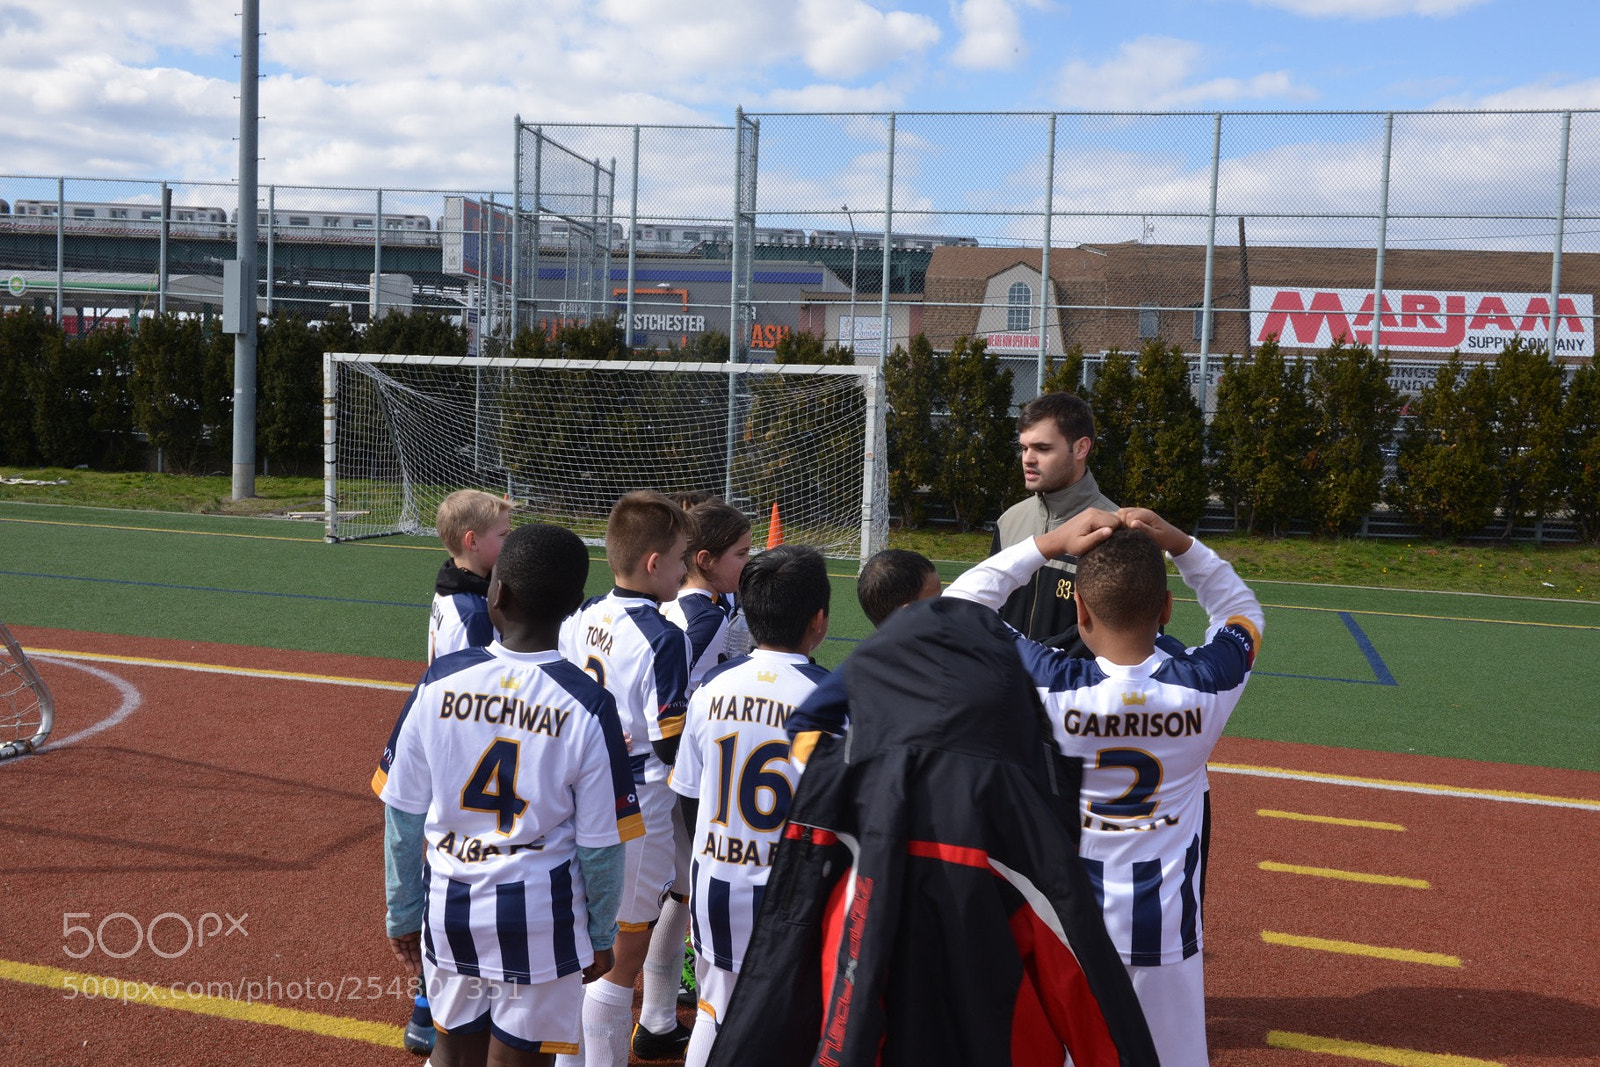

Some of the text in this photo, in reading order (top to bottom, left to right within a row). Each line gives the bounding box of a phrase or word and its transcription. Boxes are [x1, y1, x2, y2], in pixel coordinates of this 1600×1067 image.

[616, 313, 705, 332] WSTCHESTER
[750, 324, 789, 349] ASH
[1257, 291, 1585, 348] MARJAM
[1520, 337, 1585, 352] COMANY
[586, 625, 614, 656] TOMA
[439, 690, 571, 738] BOTCHWAY
[708, 695, 800, 730] MARTIN
[1064, 707, 1202, 738] GARRISON
[460, 736, 530, 838] 4
[710, 731, 795, 833] 16
[1086, 746, 1165, 820] 2
